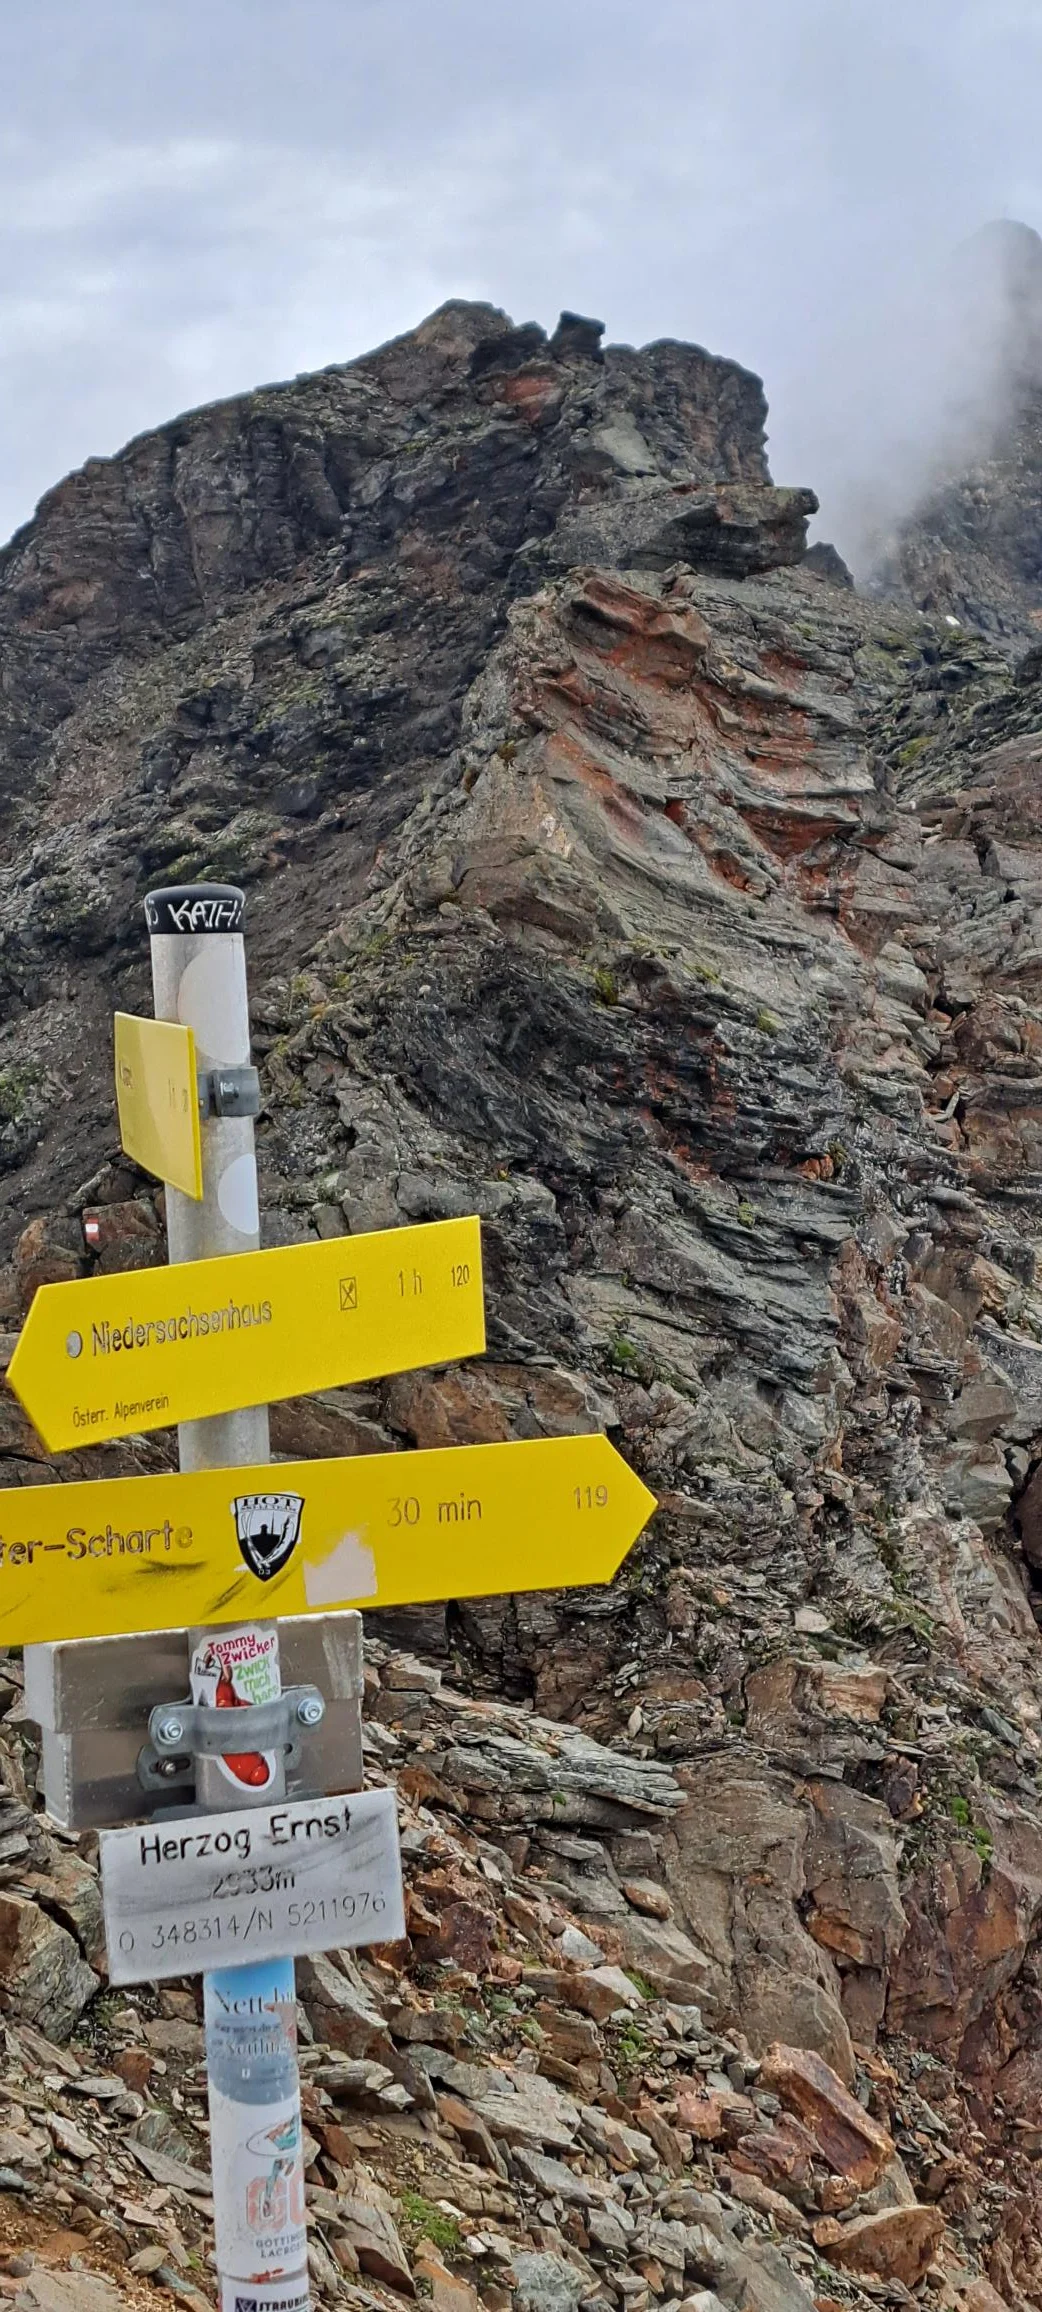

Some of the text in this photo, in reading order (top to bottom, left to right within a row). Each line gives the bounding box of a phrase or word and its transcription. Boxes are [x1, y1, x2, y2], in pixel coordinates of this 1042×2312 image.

[398, 1264, 470, 1297] 1 h 120
[91, 1298, 273, 1357] Niedersachsenhaus
[73, 1392, 170, 1428] Österr. Alpenverein
[242, 1496, 298, 1508] HOT
[387, 1484, 609, 1528] 30 min 119
[207, 1634, 256, 1656] Tommy
[140, 1806, 352, 1866] Herzog Ernst
[211, 1864, 297, 1899] 2933m
[152, 1907, 273, 1949] 348314/N
[287, 1891, 386, 1927] 5211976
